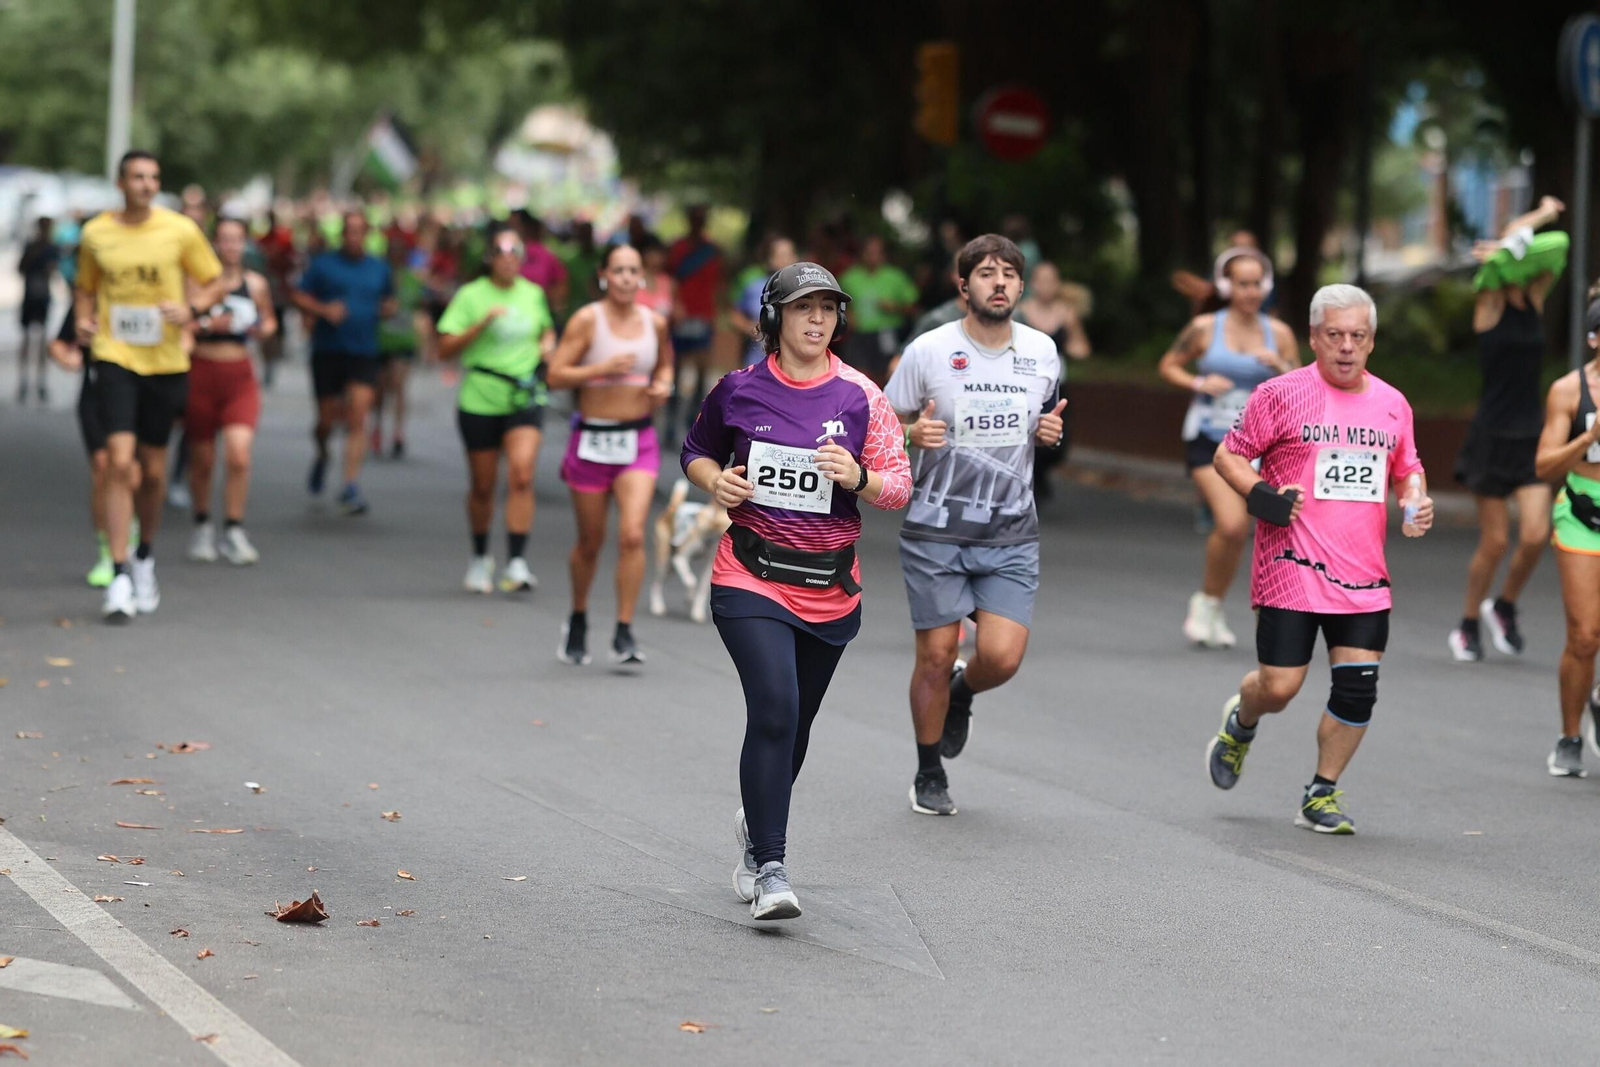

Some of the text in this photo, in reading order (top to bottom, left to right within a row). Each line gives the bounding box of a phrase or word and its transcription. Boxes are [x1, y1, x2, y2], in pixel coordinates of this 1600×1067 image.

[964, 383, 1028, 394] MARATON
[963, 413, 1020, 430] 1582
[1303, 425, 1397, 451] DONA MEDULA
[757, 465, 819, 493] 250
[1325, 465, 1373, 484] 422
